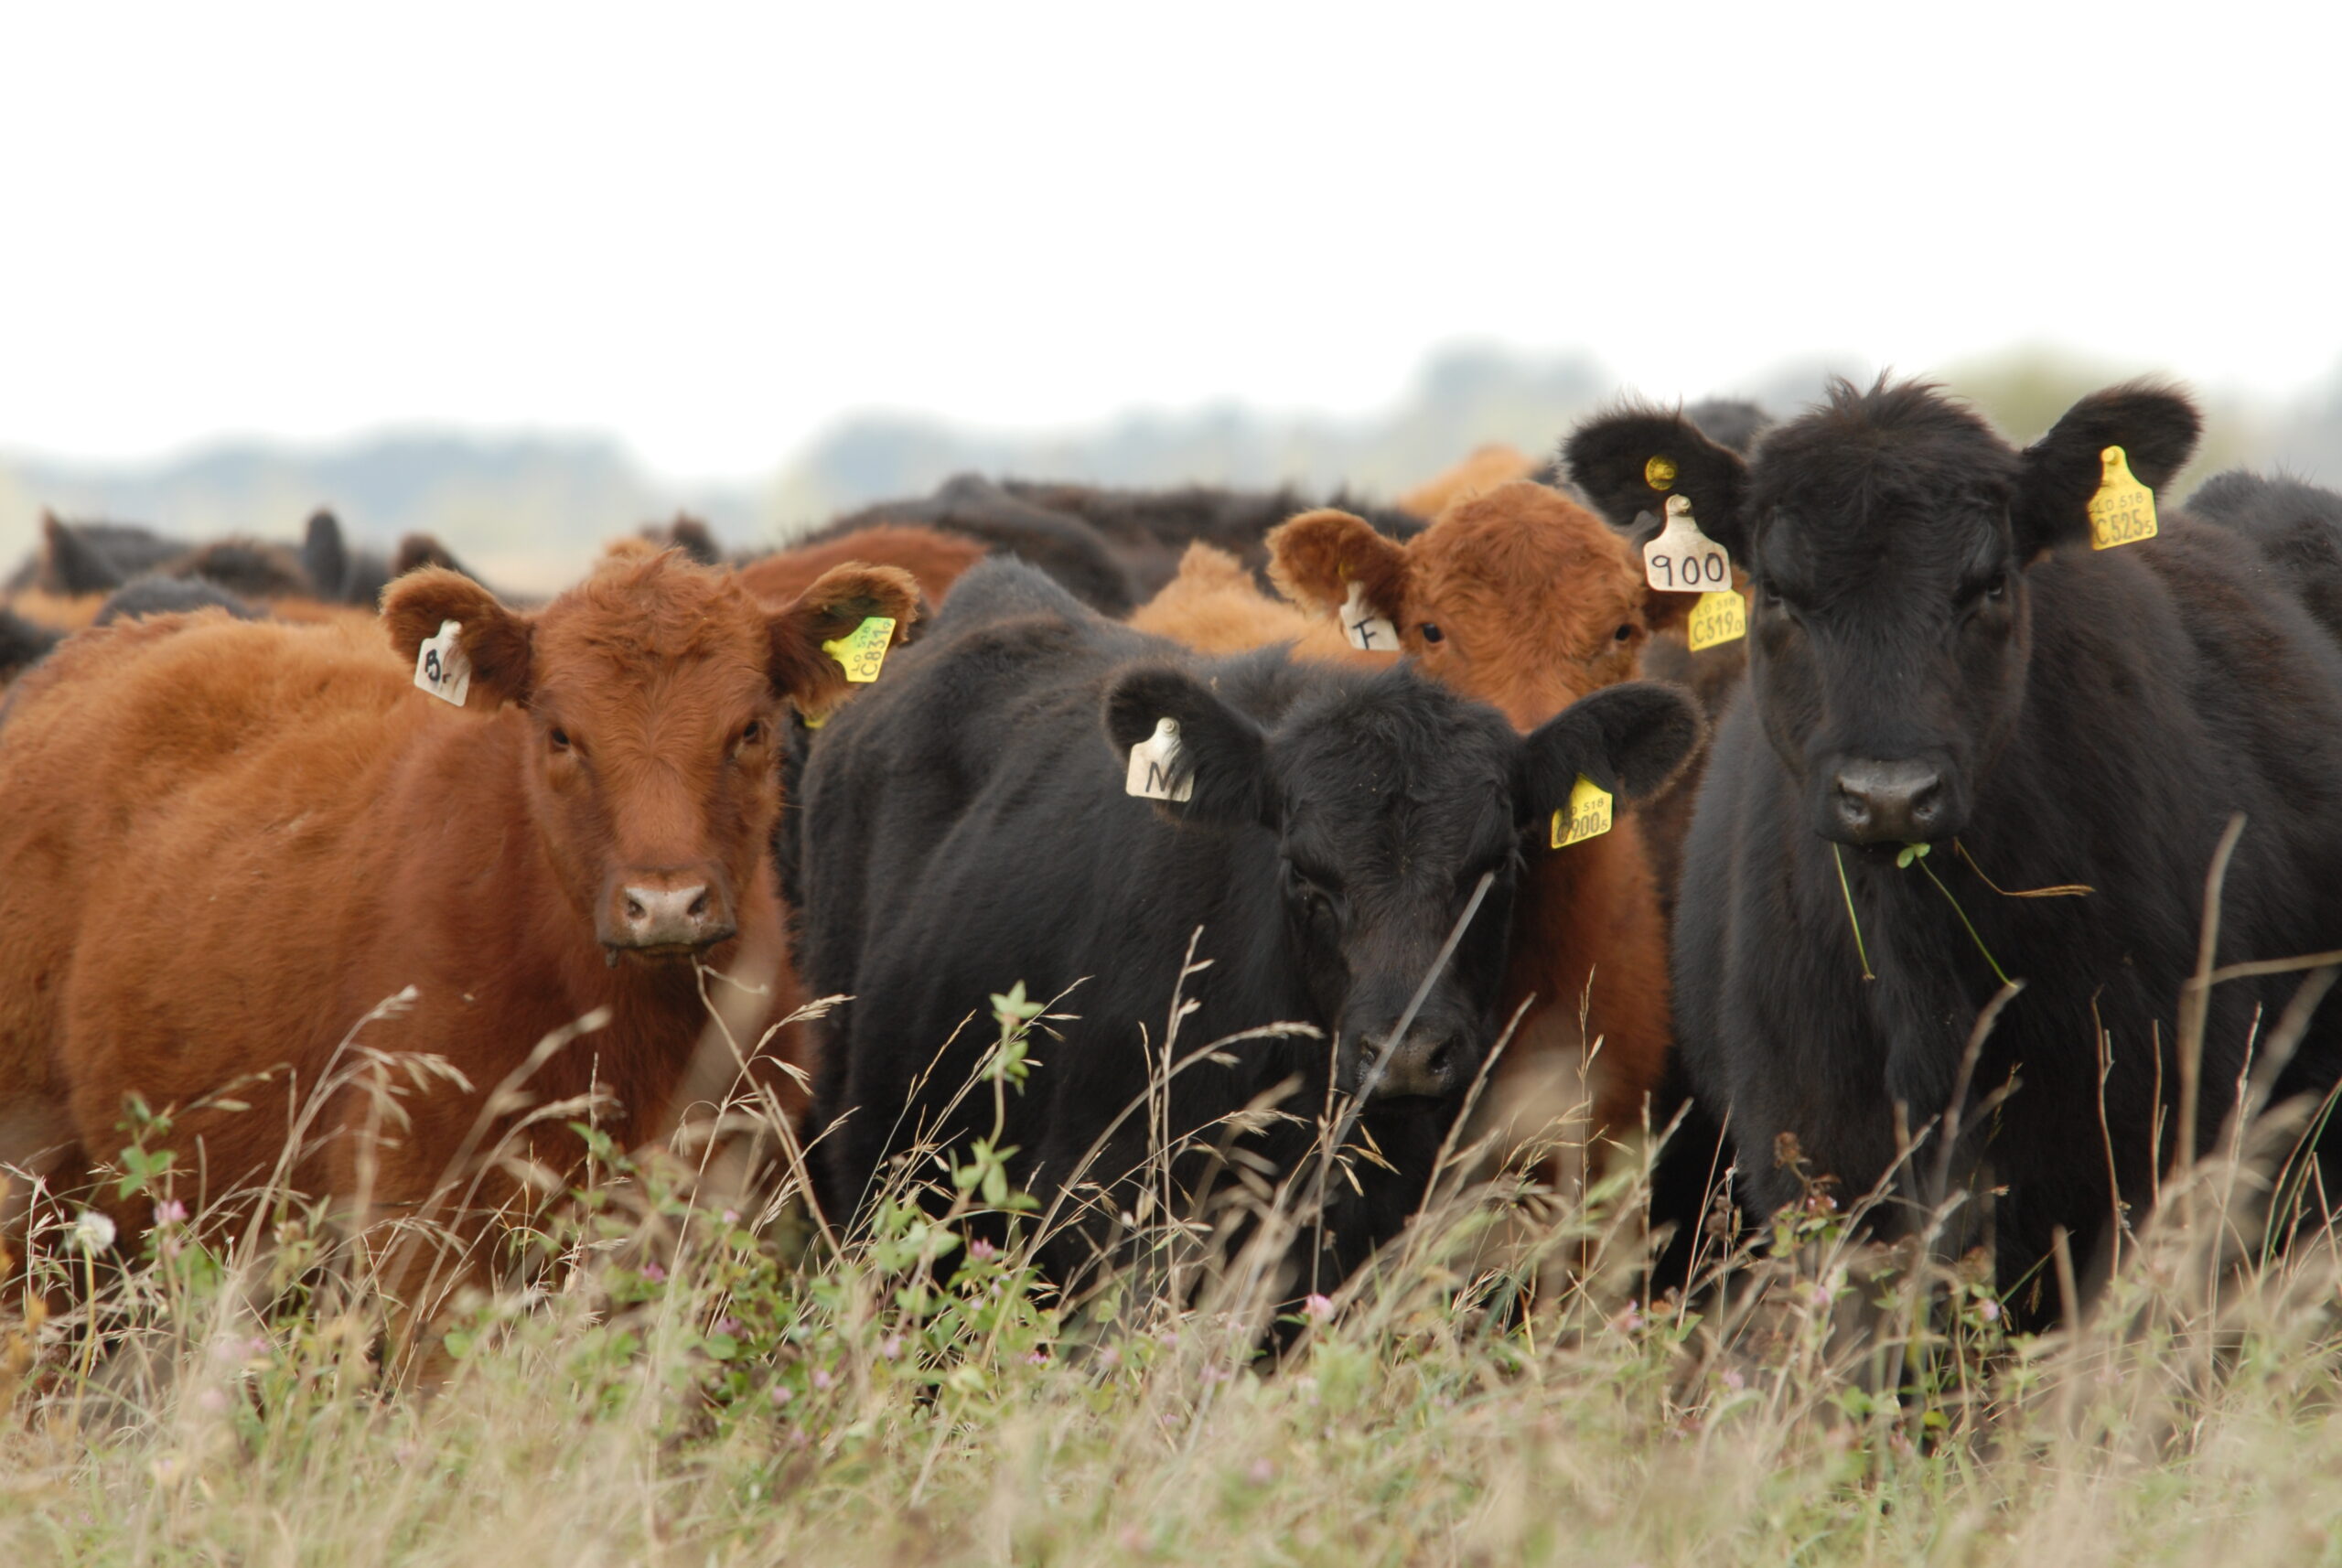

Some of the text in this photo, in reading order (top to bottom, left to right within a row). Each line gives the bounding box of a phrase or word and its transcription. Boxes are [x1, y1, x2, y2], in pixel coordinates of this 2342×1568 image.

[2120, 491, 2143, 508] 518
[1651, 552, 1724, 587] 900
[1352, 616, 1377, 650] F
[1145, 761, 1176, 793] N
[1583, 797, 1604, 812] 518
